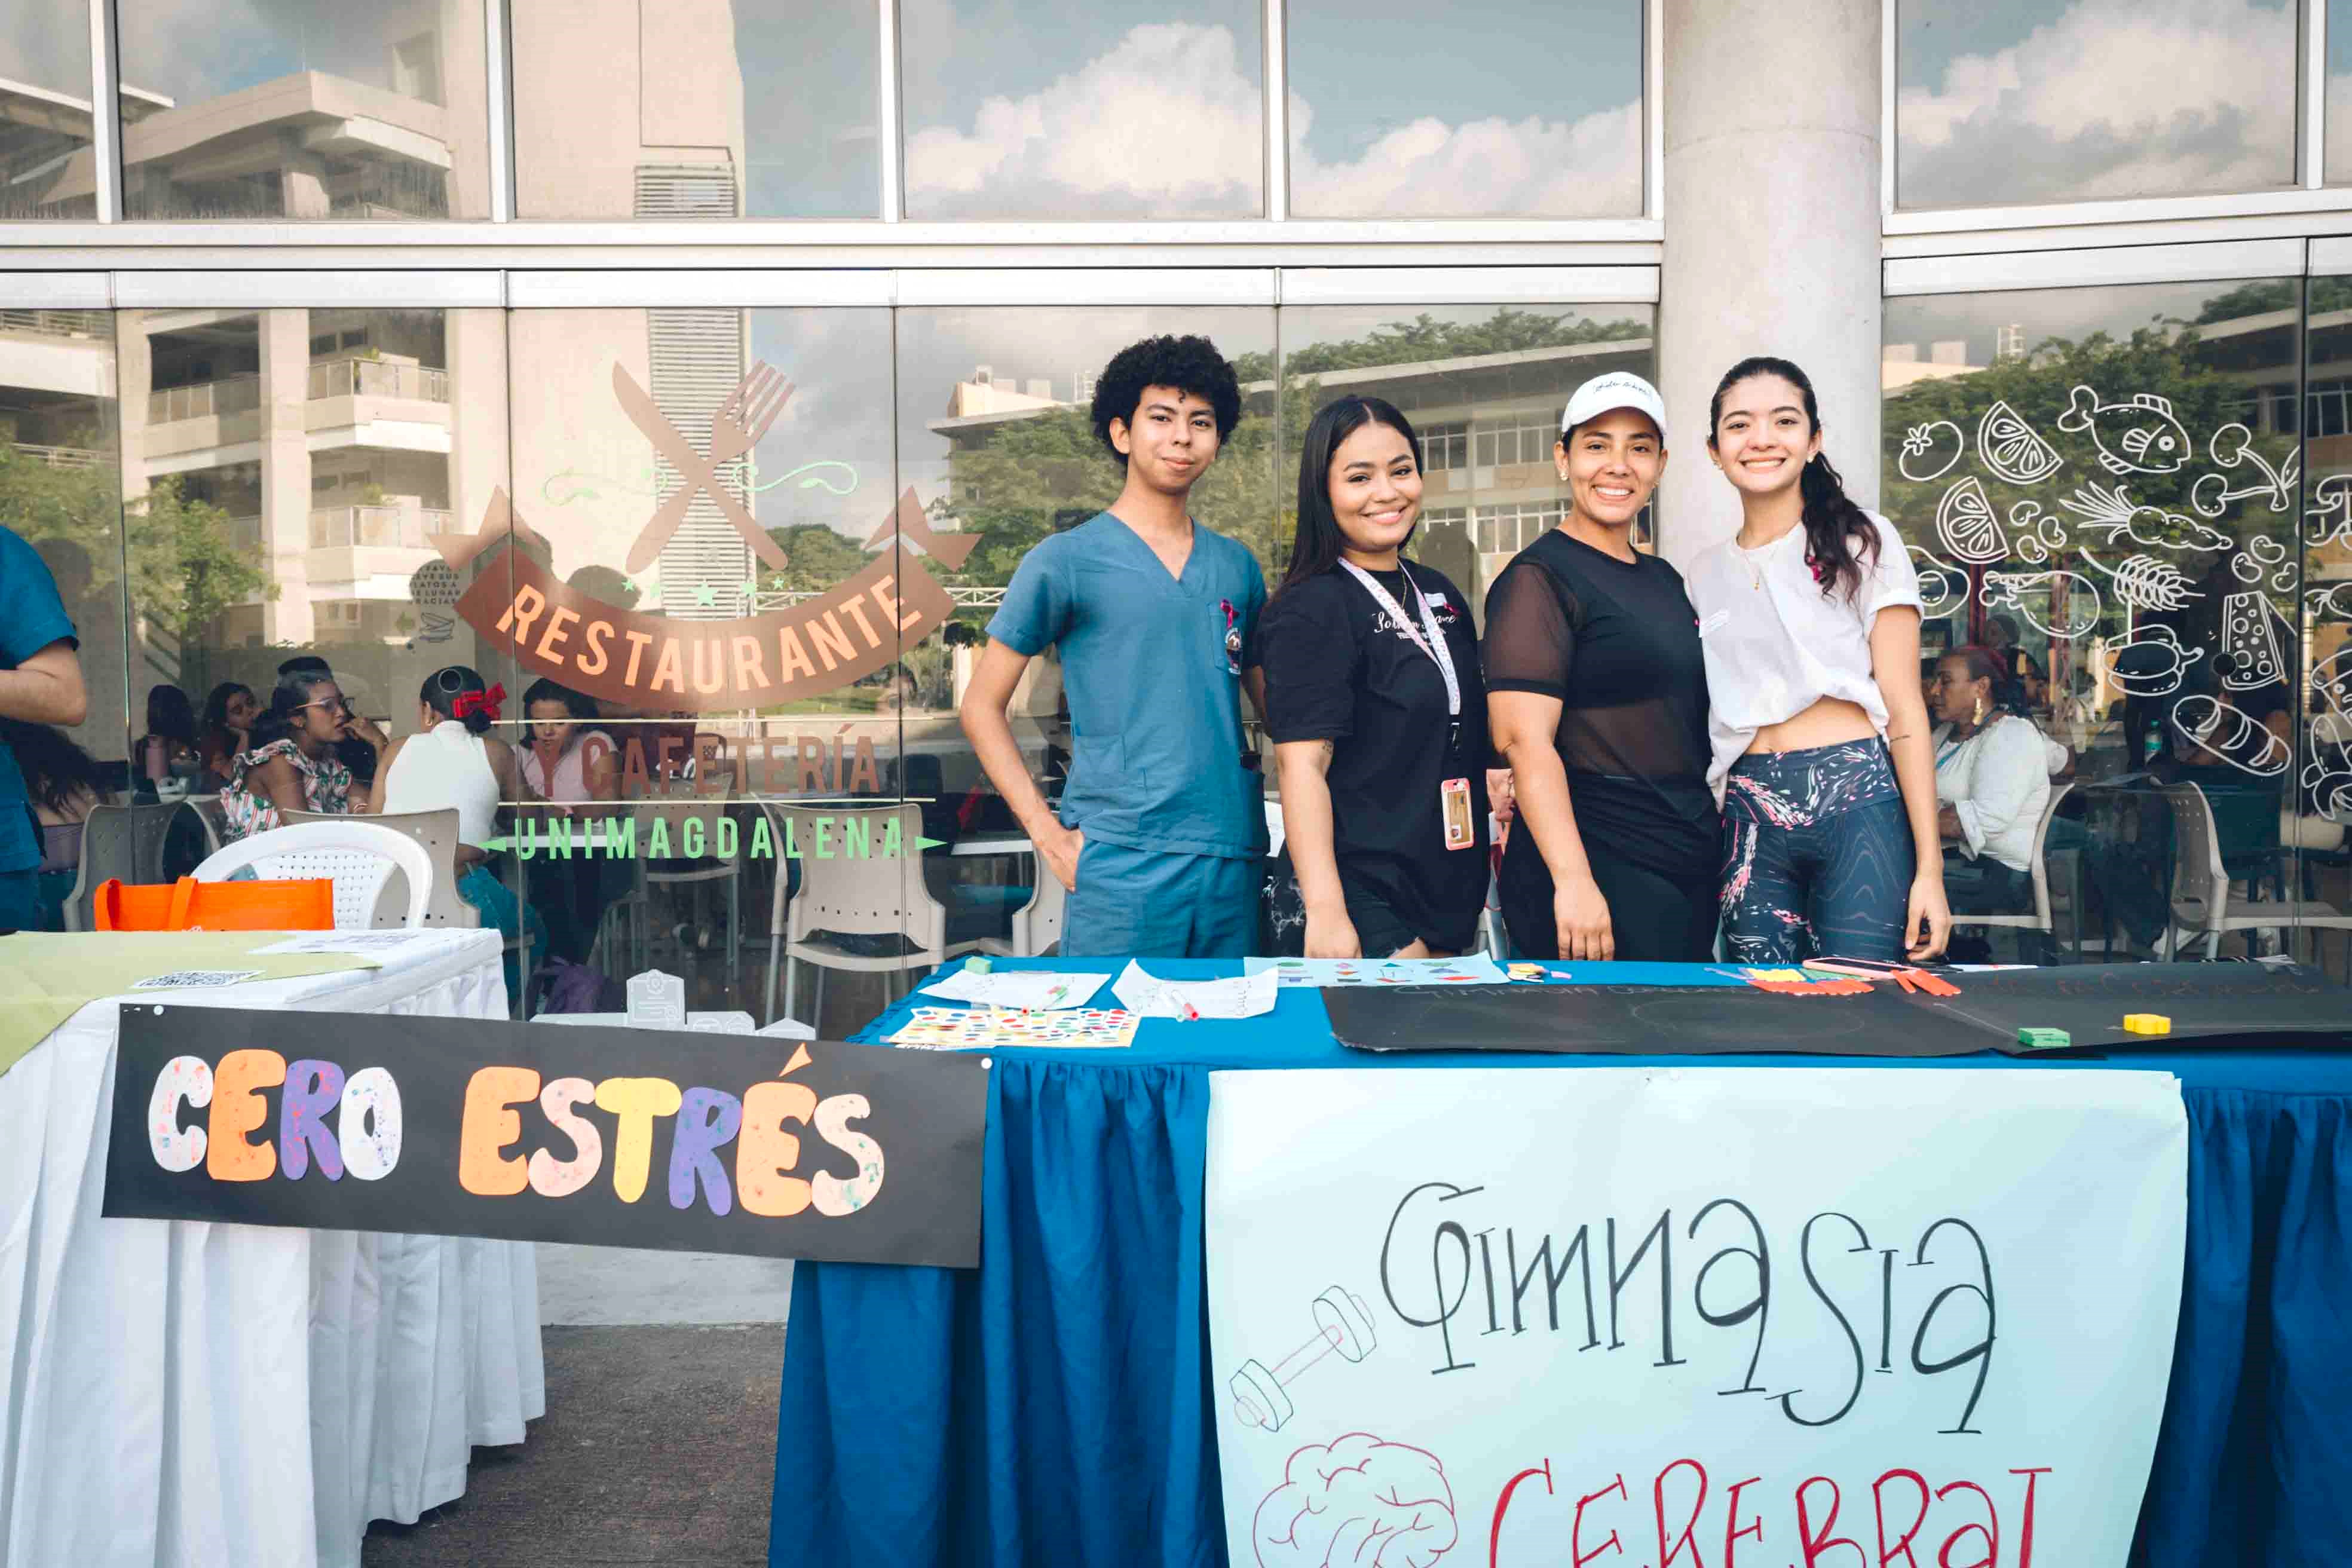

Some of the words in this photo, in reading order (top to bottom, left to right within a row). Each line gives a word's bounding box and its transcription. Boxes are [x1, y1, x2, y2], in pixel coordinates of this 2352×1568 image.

[496, 574, 922, 694] RESTAURANTE
[532, 742, 563, 798] Y
[581, 723, 880, 795] CAFETERÍA
[514, 816, 904, 860] UNIMAGDALENA
[148, 1049, 402, 1181] CERO
[459, 1042, 885, 1217] ESTRÉS
